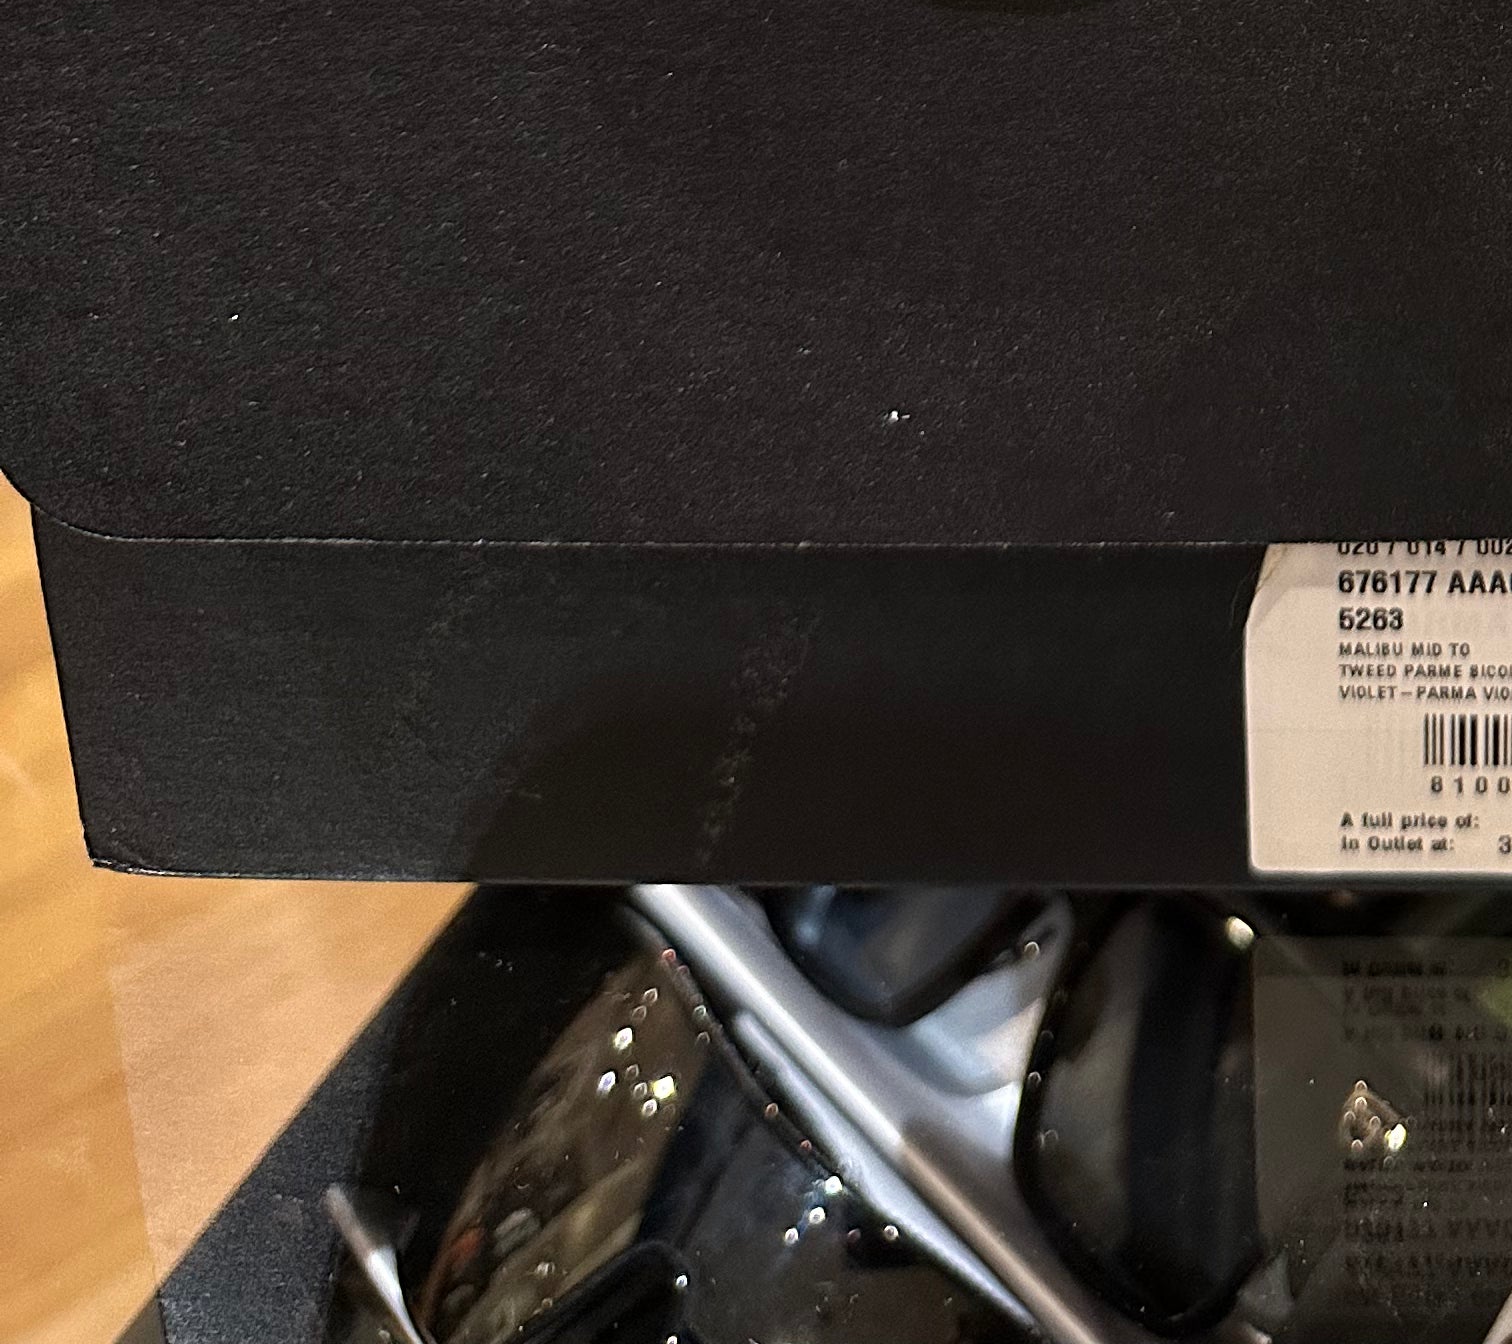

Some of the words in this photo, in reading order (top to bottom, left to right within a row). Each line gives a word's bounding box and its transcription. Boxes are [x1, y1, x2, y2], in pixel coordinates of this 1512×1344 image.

[1338, 570, 1437, 594] 676177
[1339, 608, 1403, 631] 5263
[1339, 642, 1403, 658] MALIBU
[1411, 643, 1442, 658] MID
[1449, 643, 1470, 659] TO
[1340, 664, 1396, 678] TWEED
[1404, 665, 1461, 679] PARME
[1341, 813, 1353, 827] A
[1362, 813, 1392, 829] full
[1401, 814, 1447, 831] price
[1368, 836, 1423, 853] Outlet
